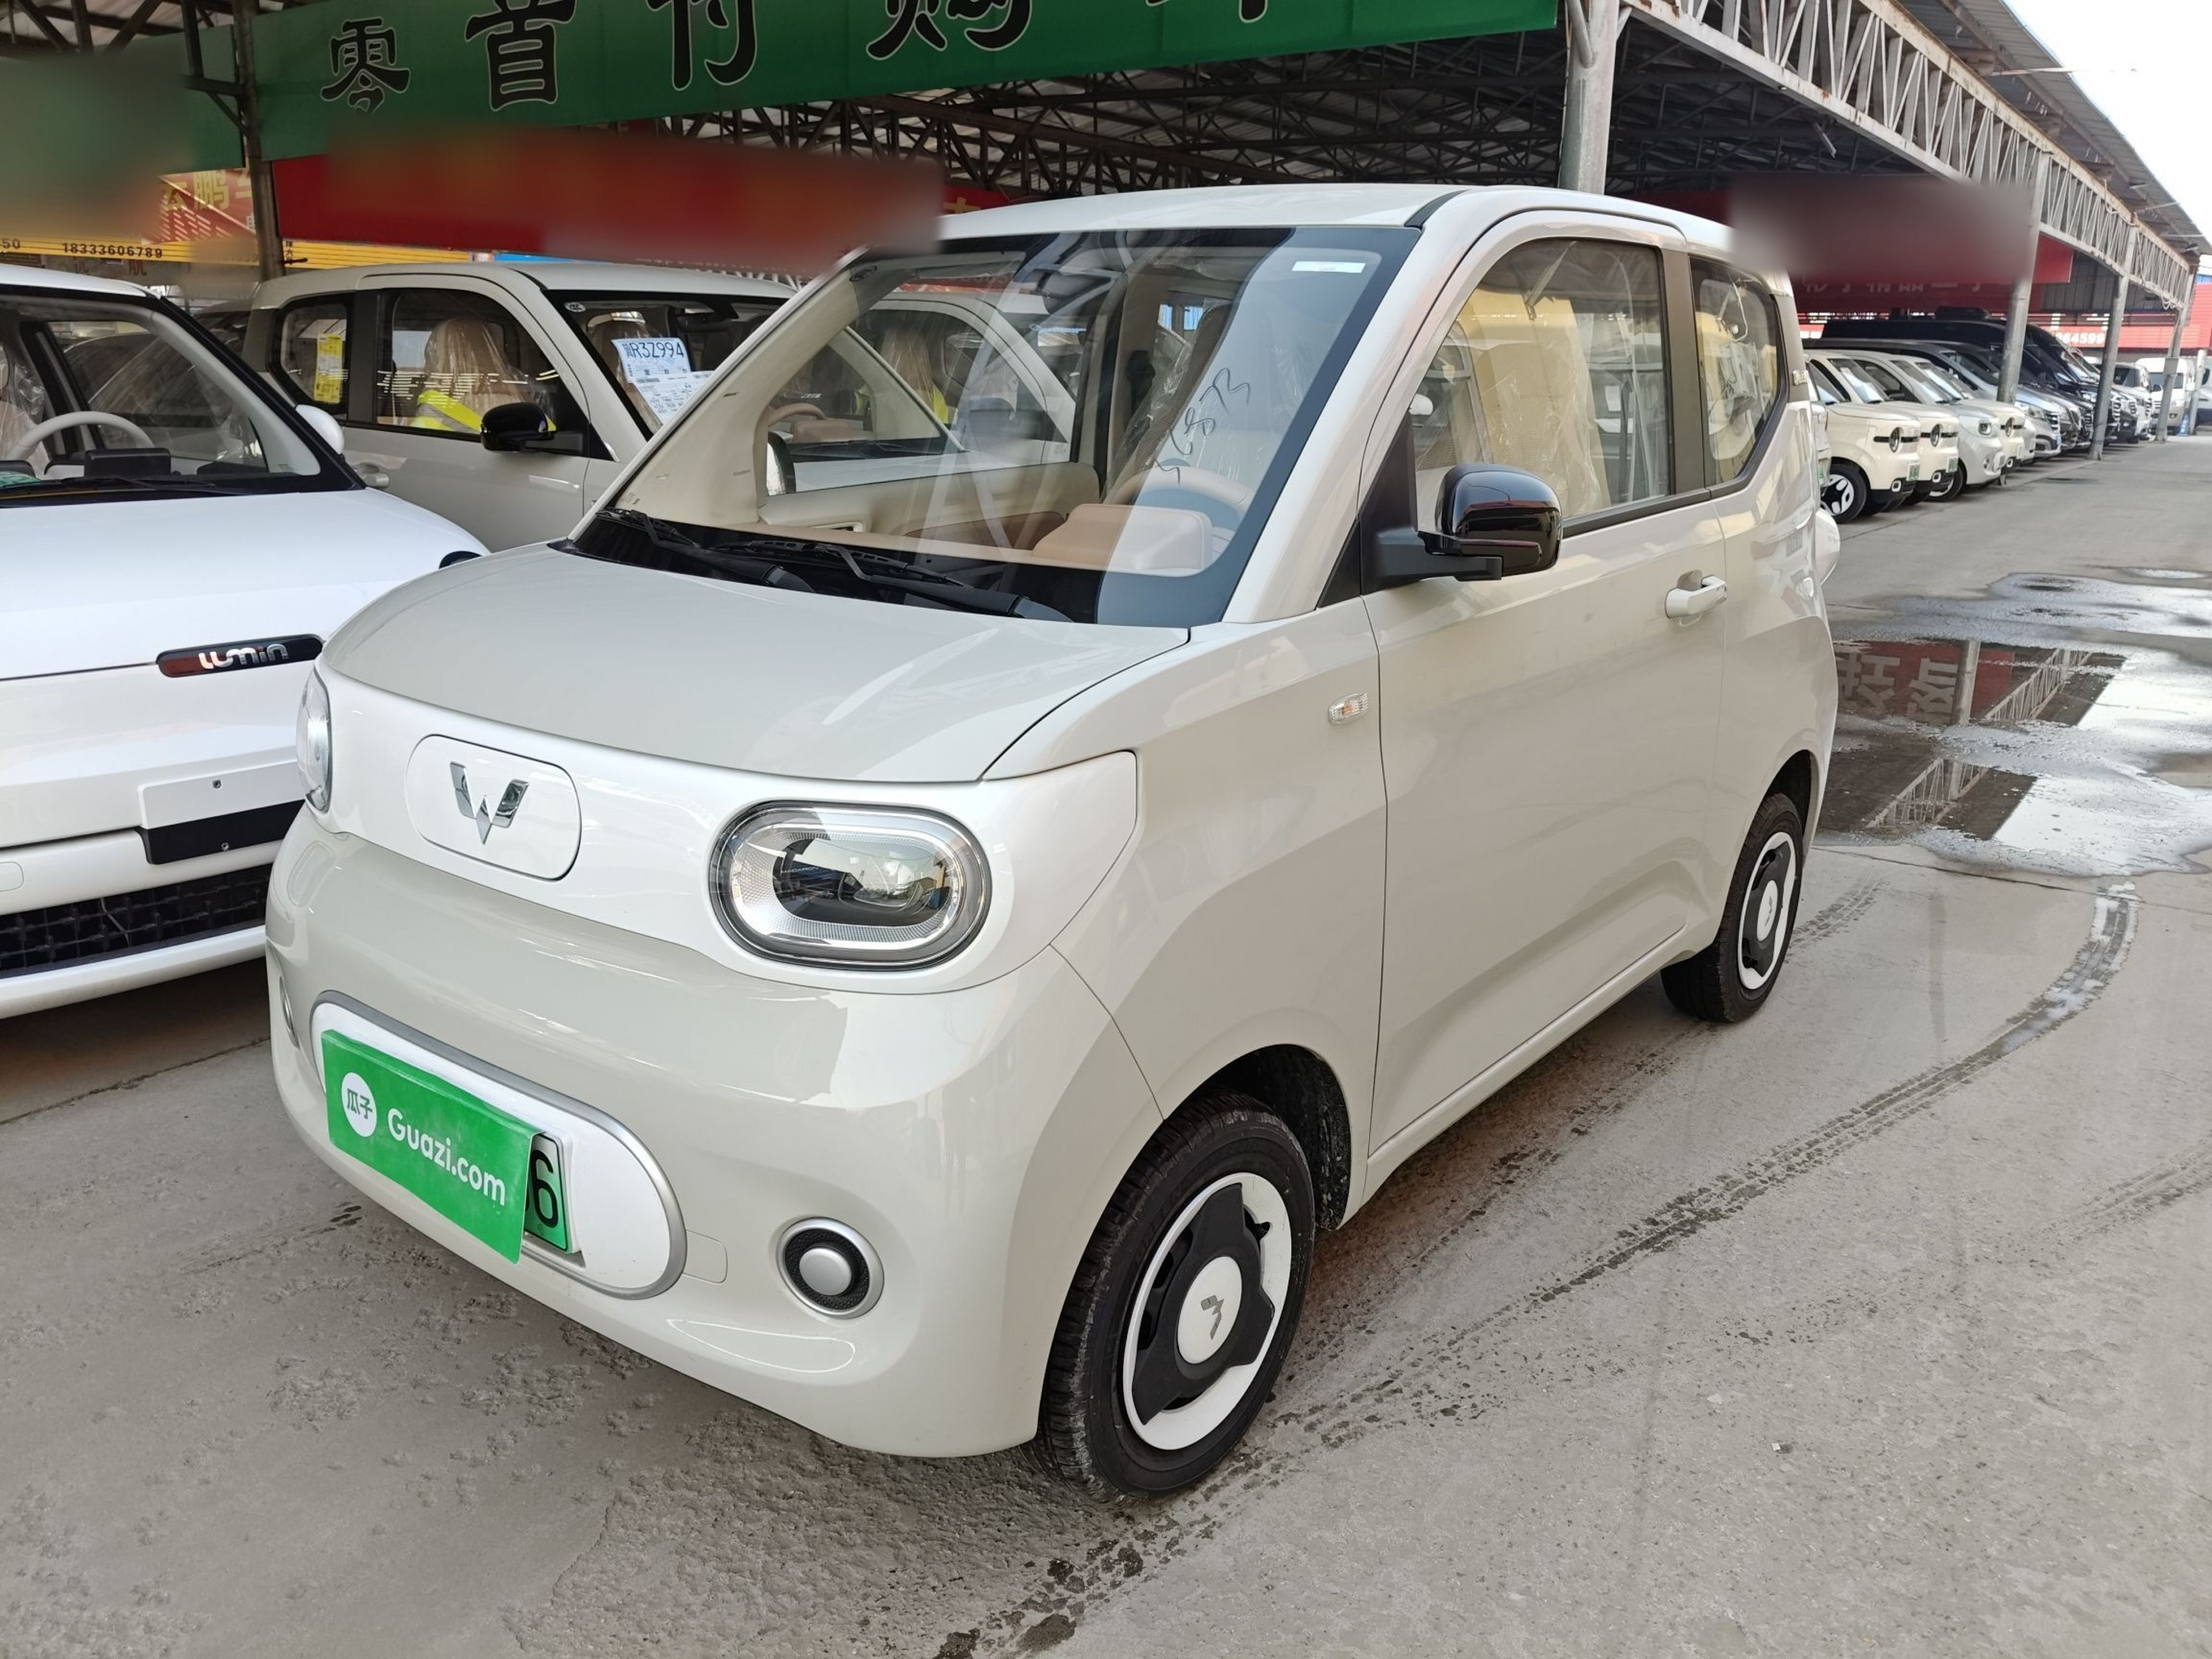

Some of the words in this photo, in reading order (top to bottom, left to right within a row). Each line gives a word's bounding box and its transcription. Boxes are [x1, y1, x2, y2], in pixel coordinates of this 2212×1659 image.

[62, 242, 162, 258] 18333606789
[347, 1088, 372, 1120] 瓜子
[388, 1108, 505, 1206] Guazi.com
[525, 1150, 559, 1228] 6
